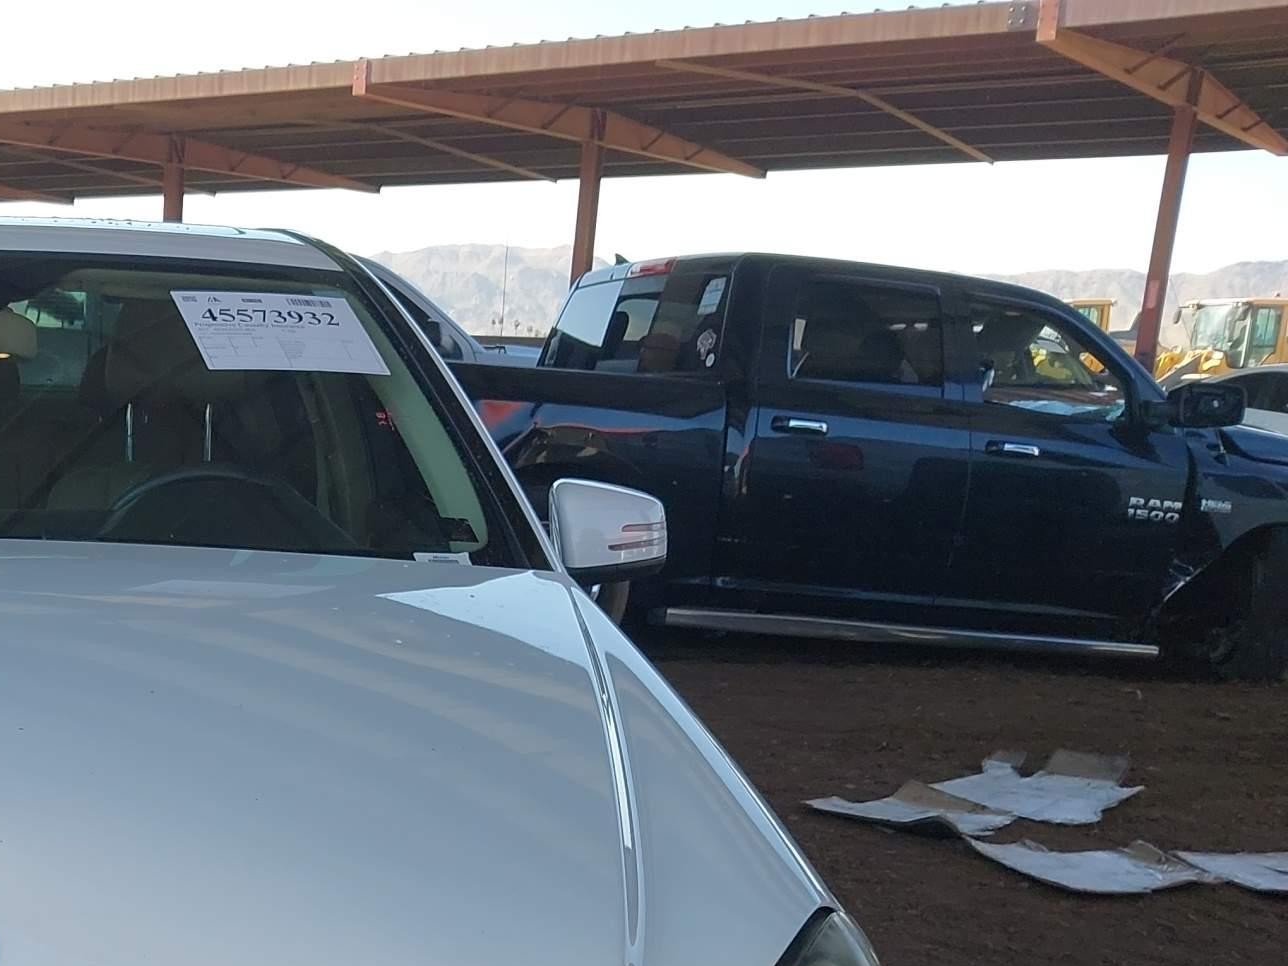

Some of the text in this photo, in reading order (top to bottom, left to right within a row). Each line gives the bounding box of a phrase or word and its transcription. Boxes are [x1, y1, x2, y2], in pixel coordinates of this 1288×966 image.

[201, 308, 340, 327] 45573932
[1129, 497, 1183, 510] RAM
[1127, 508, 1180, 522] 1500
